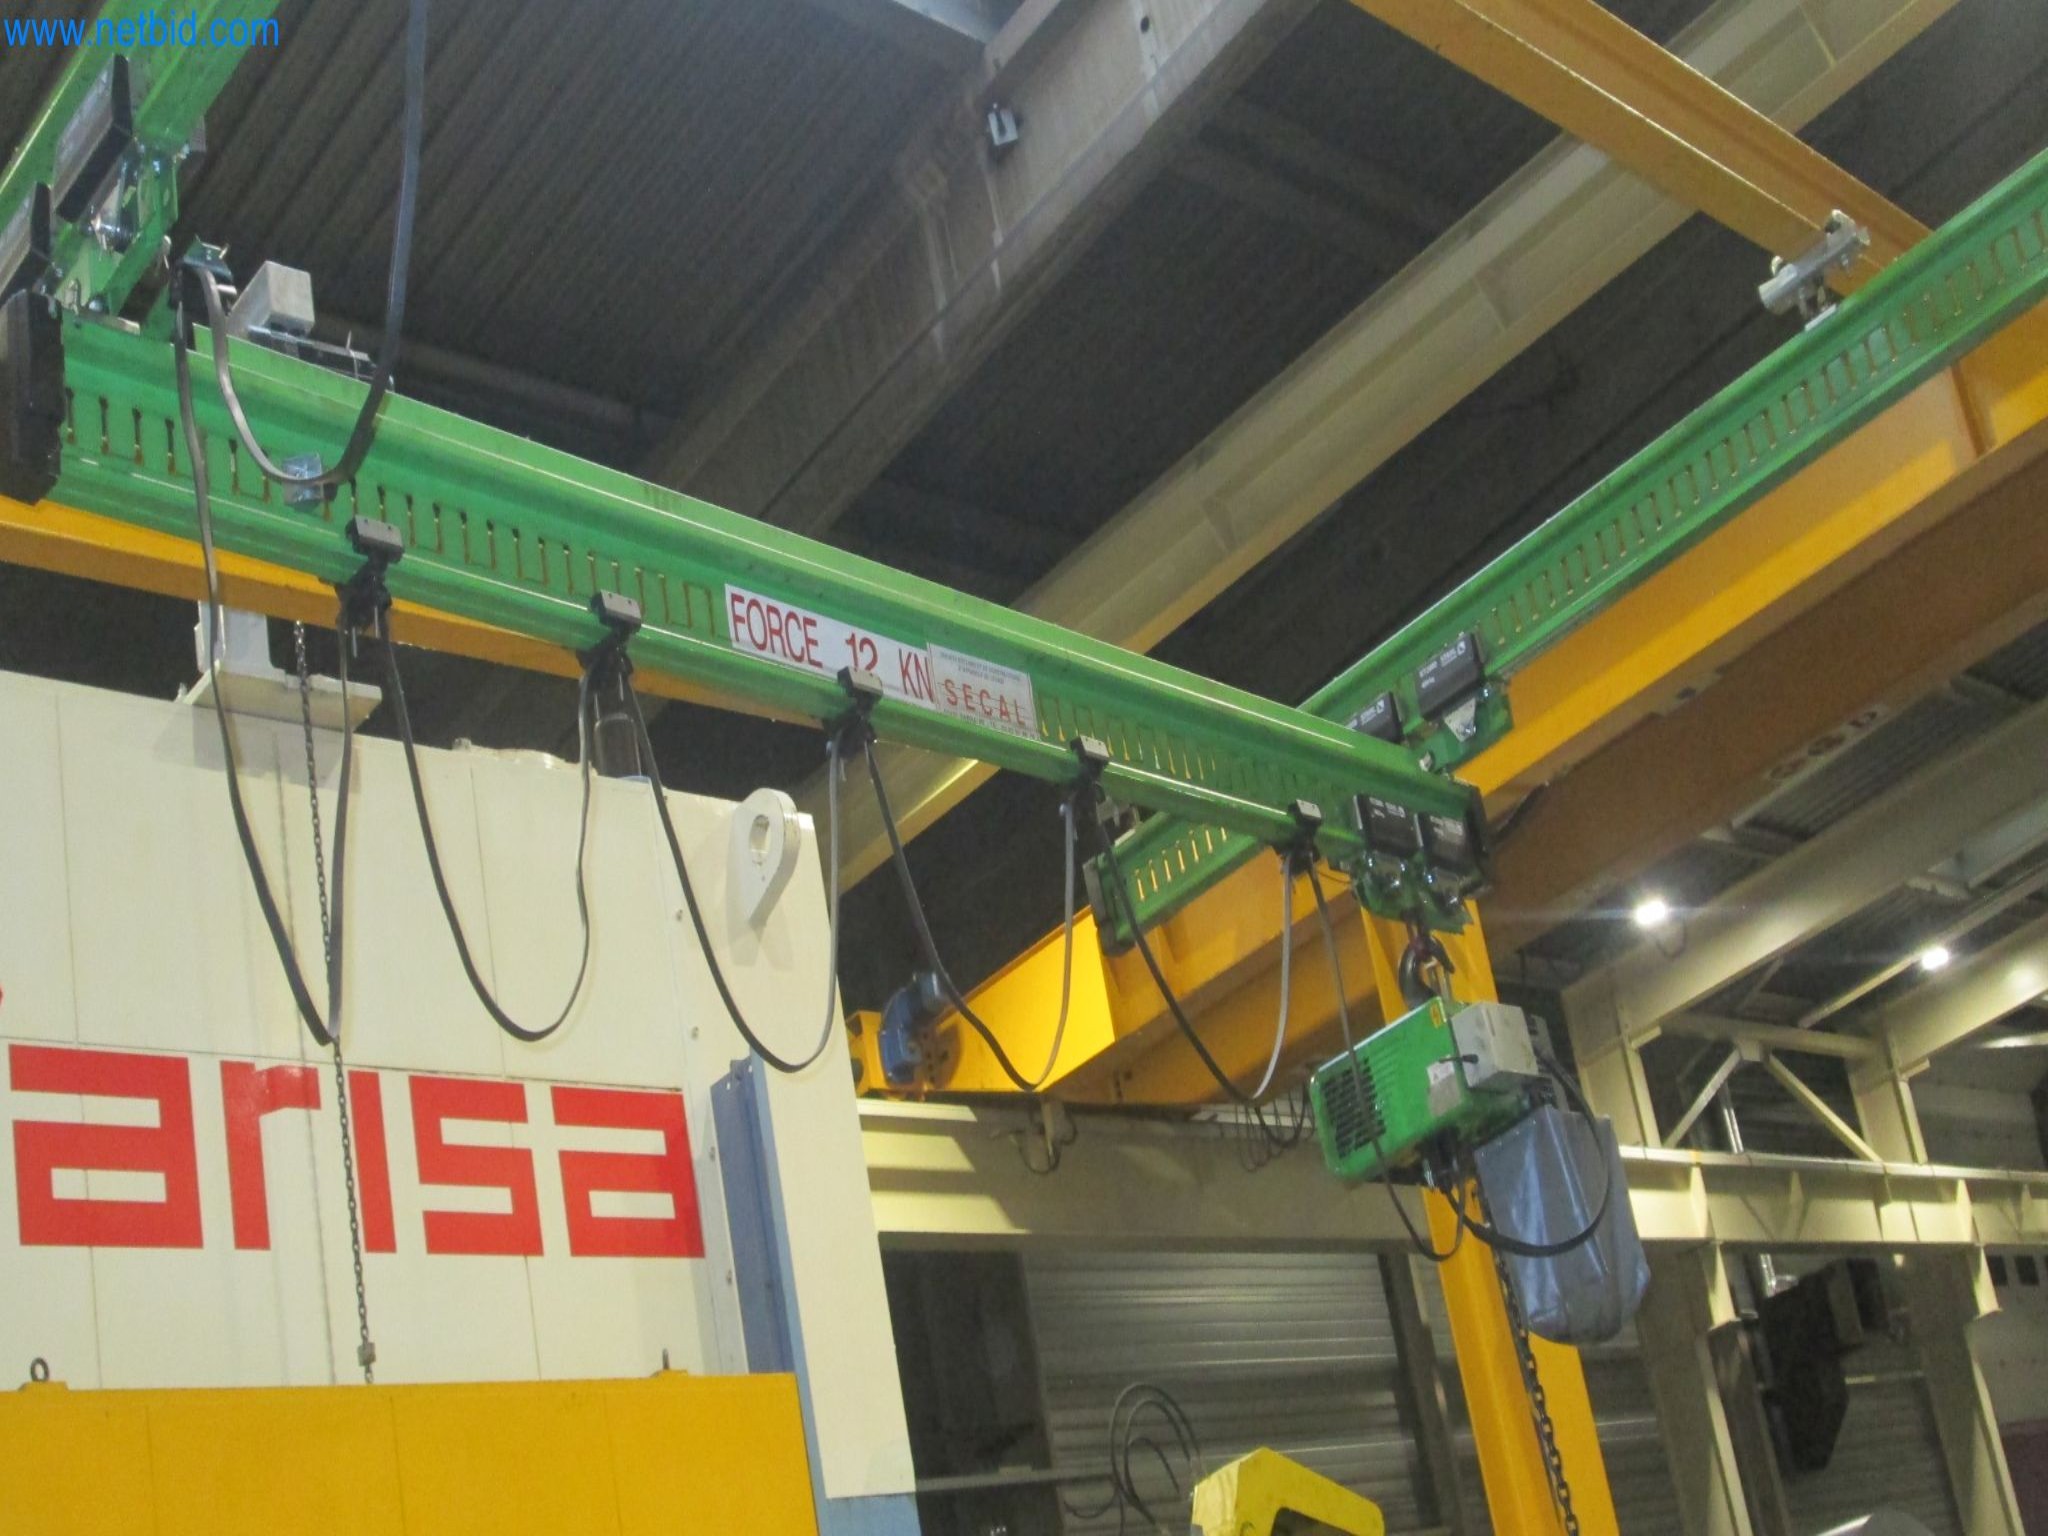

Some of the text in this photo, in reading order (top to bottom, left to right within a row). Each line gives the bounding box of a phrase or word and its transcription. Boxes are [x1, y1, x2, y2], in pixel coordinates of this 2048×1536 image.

[731, 593, 823, 668] FORCE
[898, 647, 935, 702] KN
[944, 678, 1026, 727] SECAL
[9, 1044, 705, 1258] arisa
